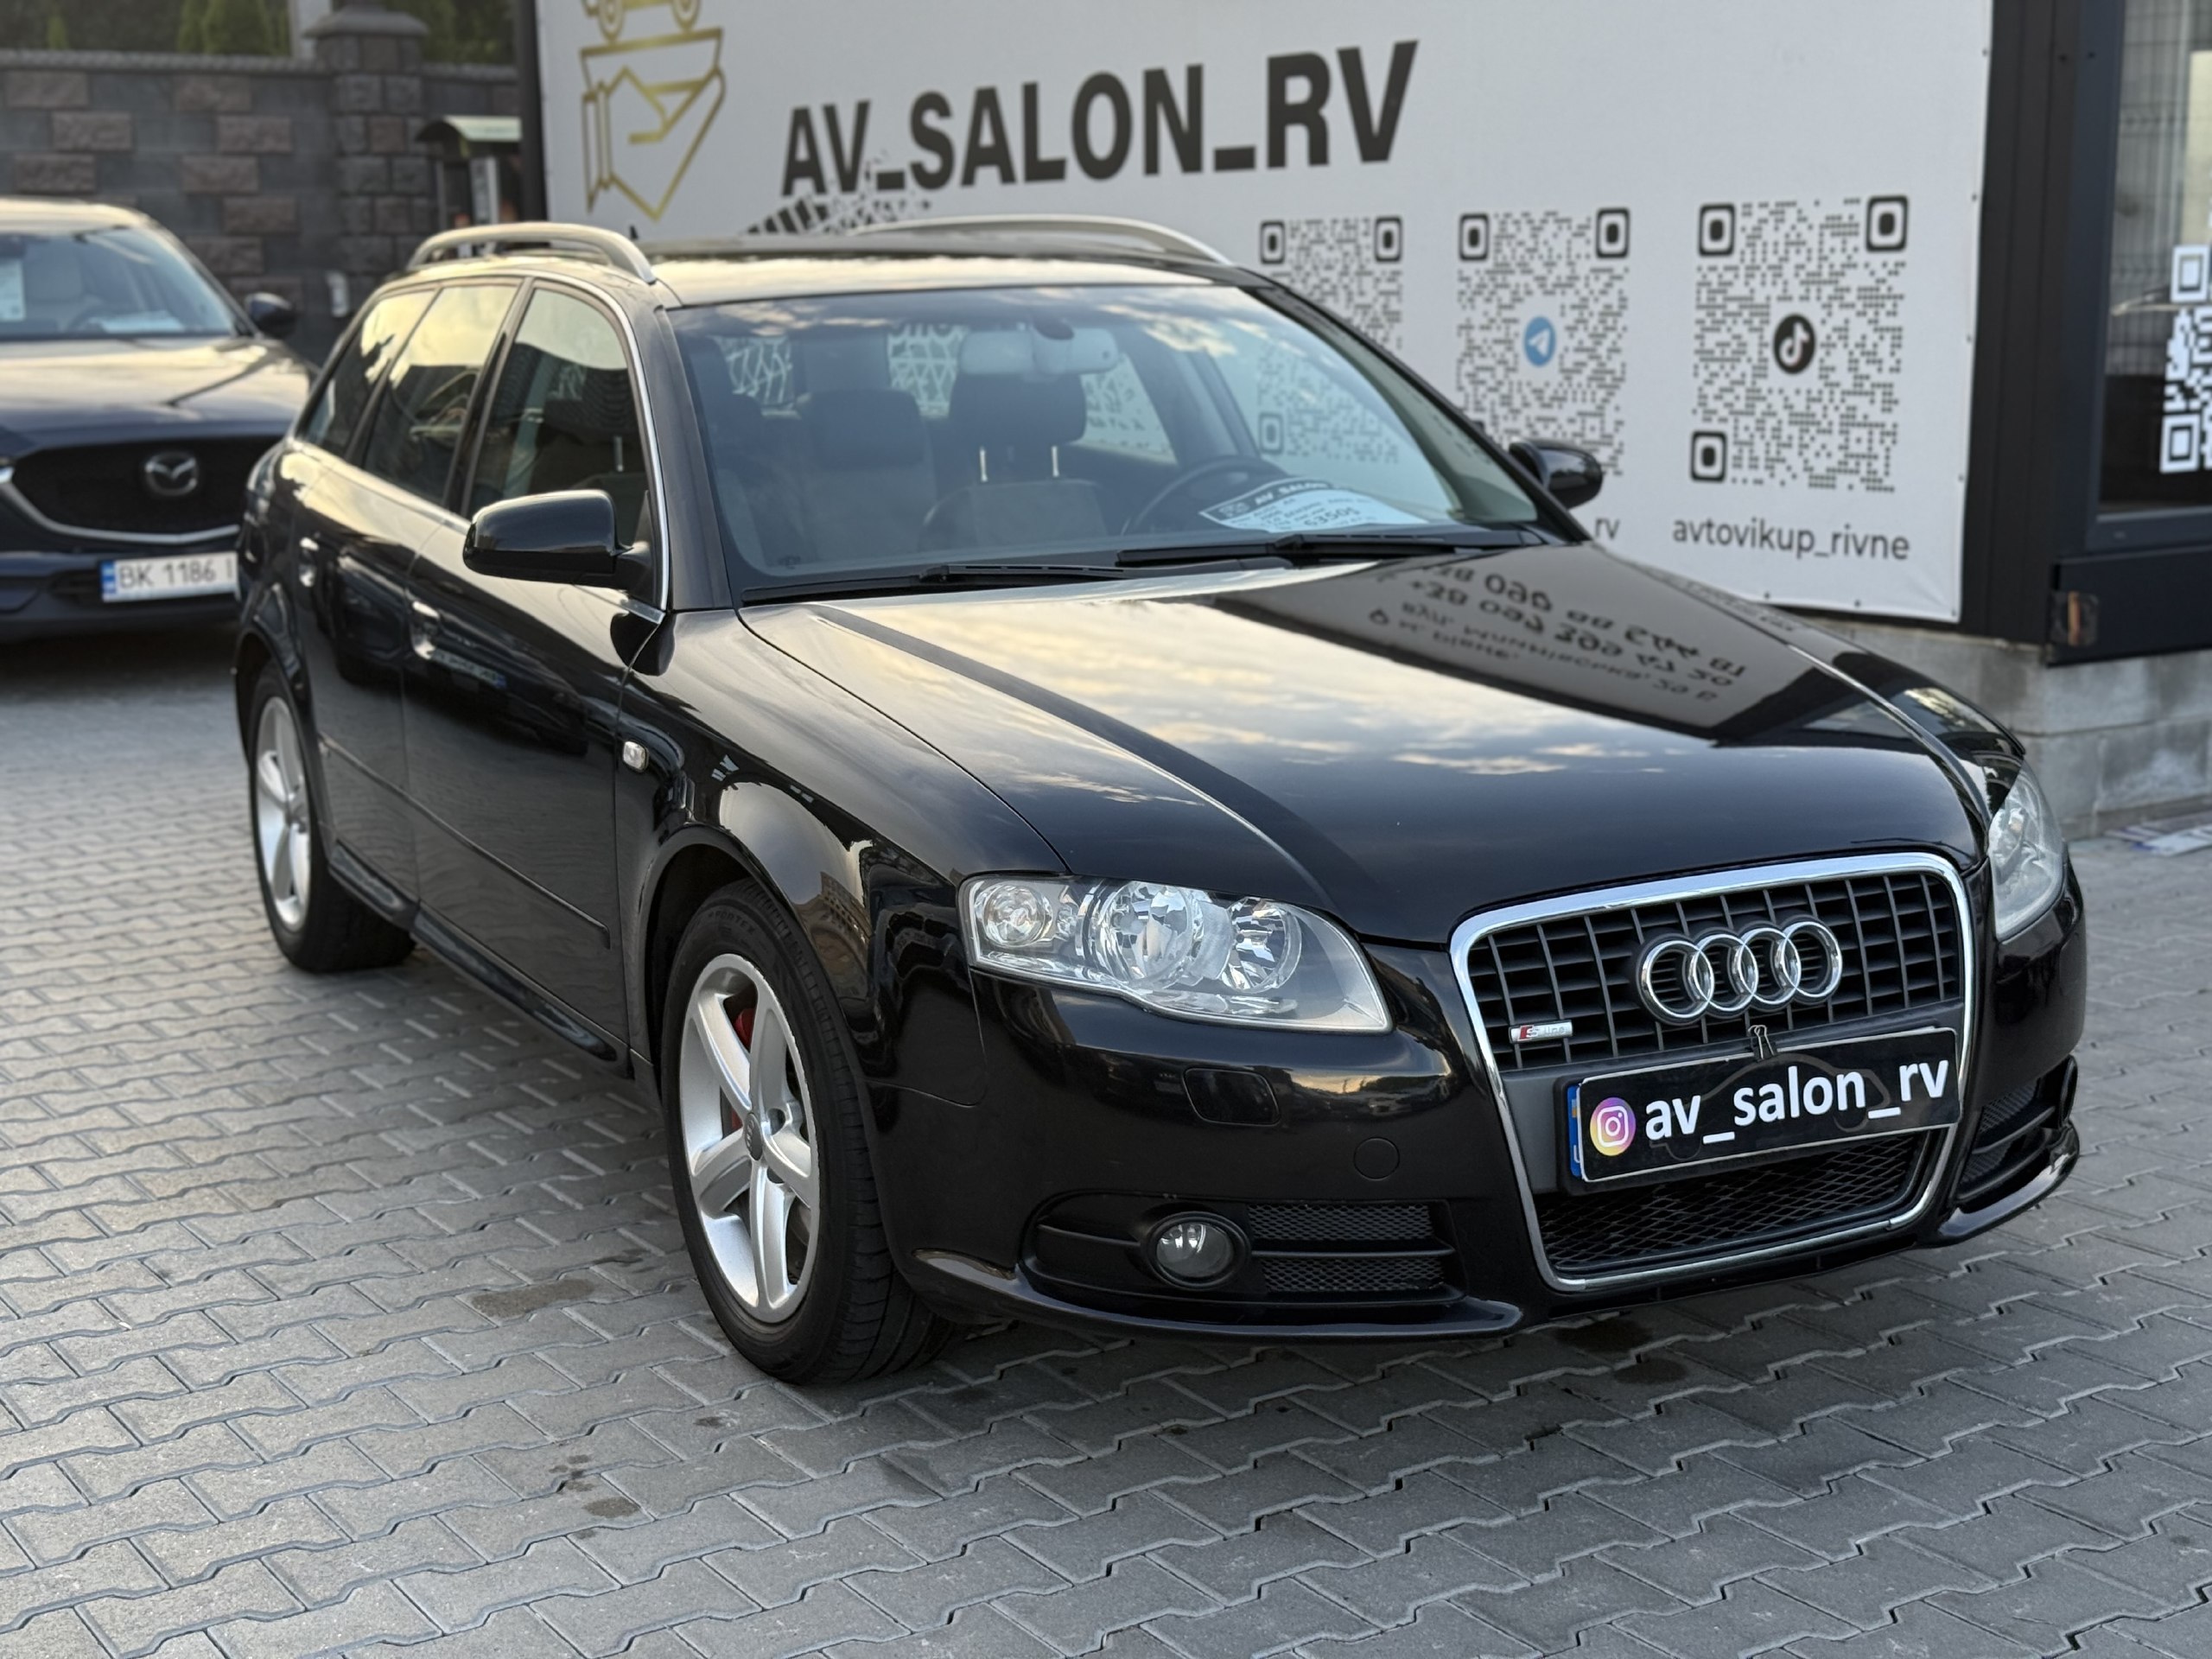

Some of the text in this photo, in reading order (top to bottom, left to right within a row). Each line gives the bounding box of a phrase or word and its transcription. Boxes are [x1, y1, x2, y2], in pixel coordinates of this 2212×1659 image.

[781, 40, 1419, 198] AV_SALON_RV
[1594, 518, 1621, 542] rv
[1672, 518, 1911, 561] avtovikup_rivne
[119, 564, 154, 588] BK
[162, 558, 216, 584] 1186
[1644, 1059, 1948, 1145] av_salon_rv
